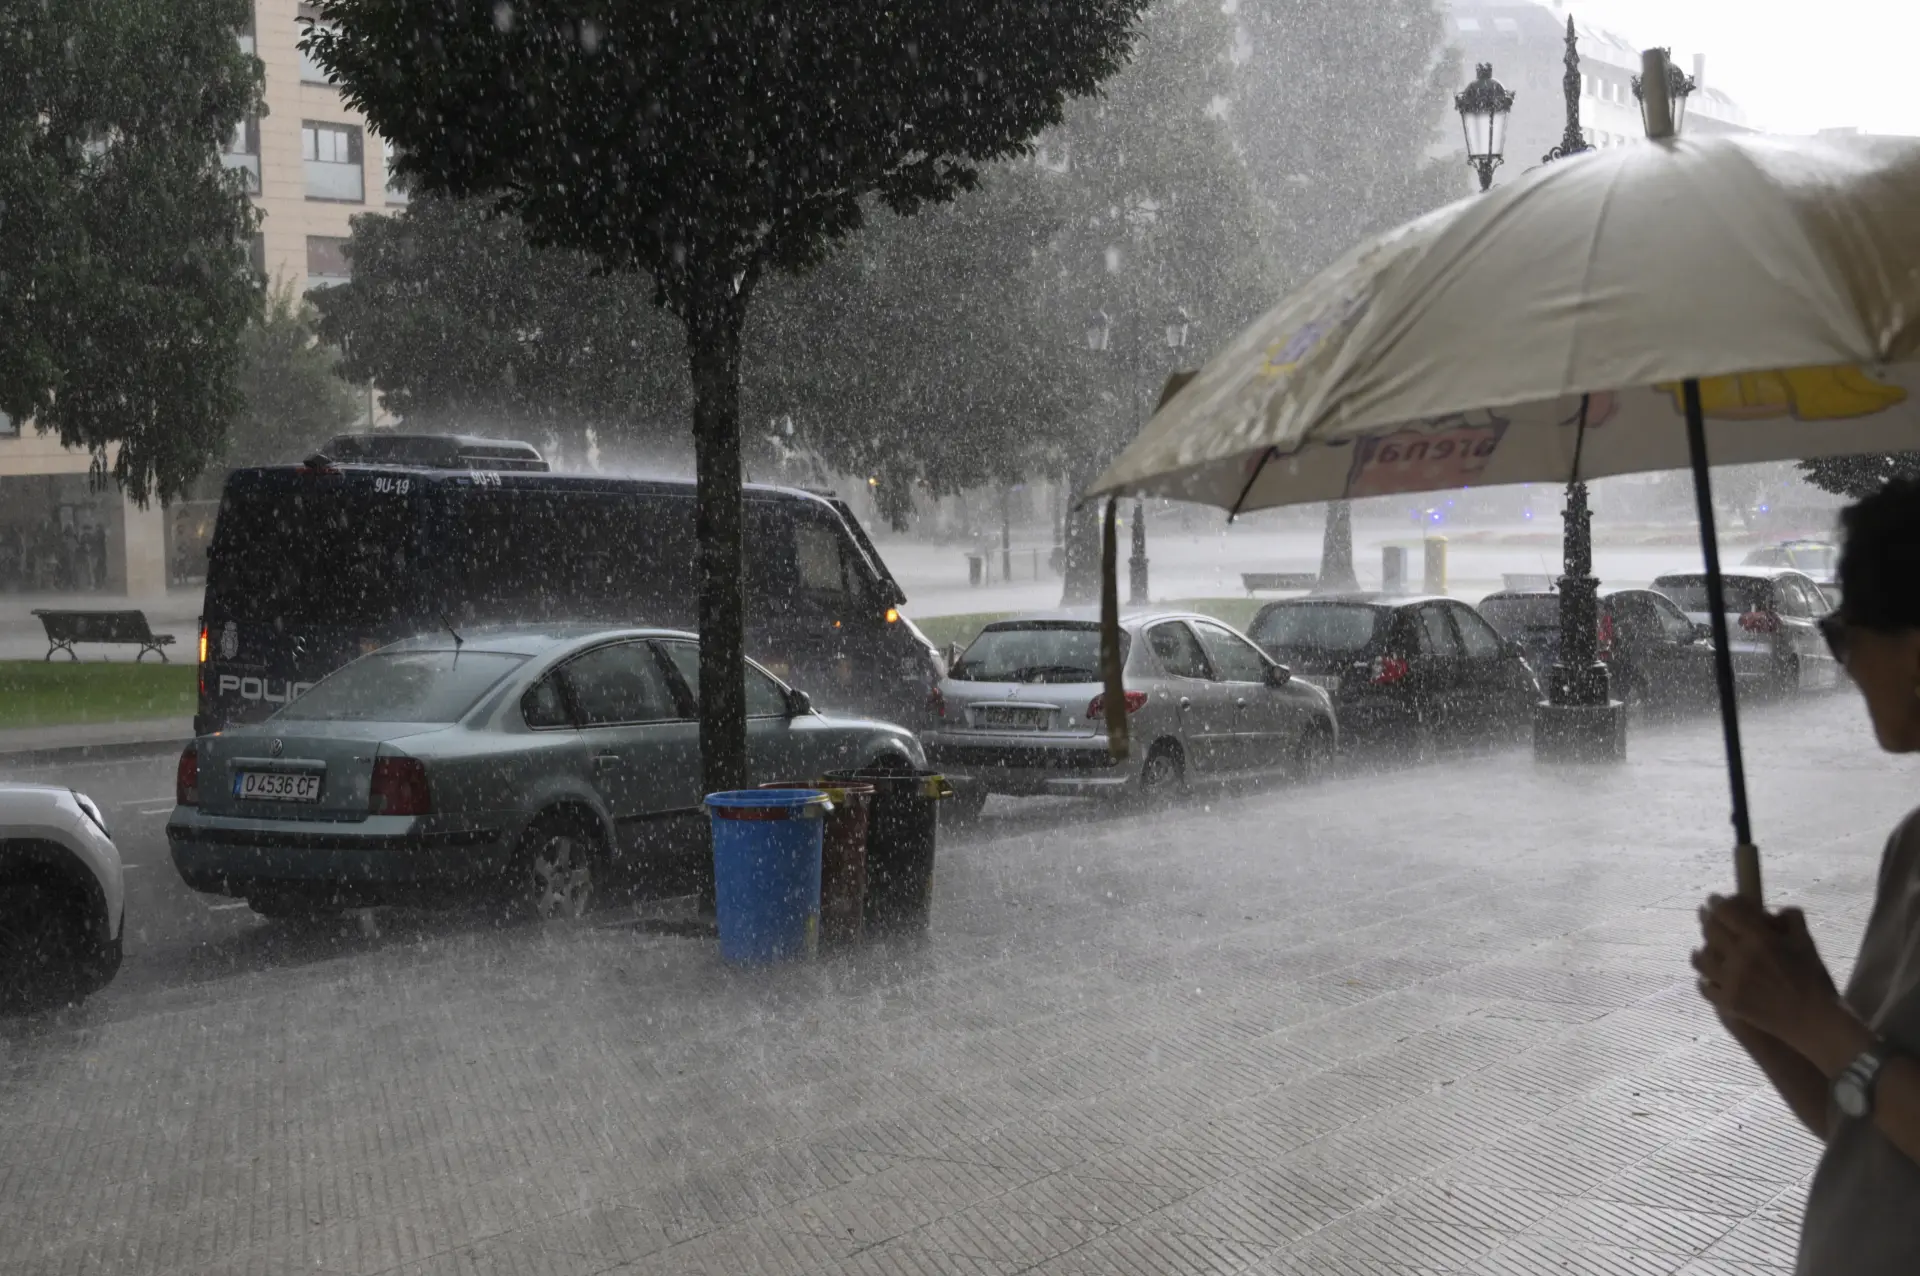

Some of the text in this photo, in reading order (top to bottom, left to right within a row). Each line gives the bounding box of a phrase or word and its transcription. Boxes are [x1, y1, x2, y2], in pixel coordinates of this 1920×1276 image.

[374, 477, 410, 495] 9U-19
[470, 471, 502, 486] 9U-19
[257, 776, 294, 794] 4536
[297, 776, 318, 796] CF
